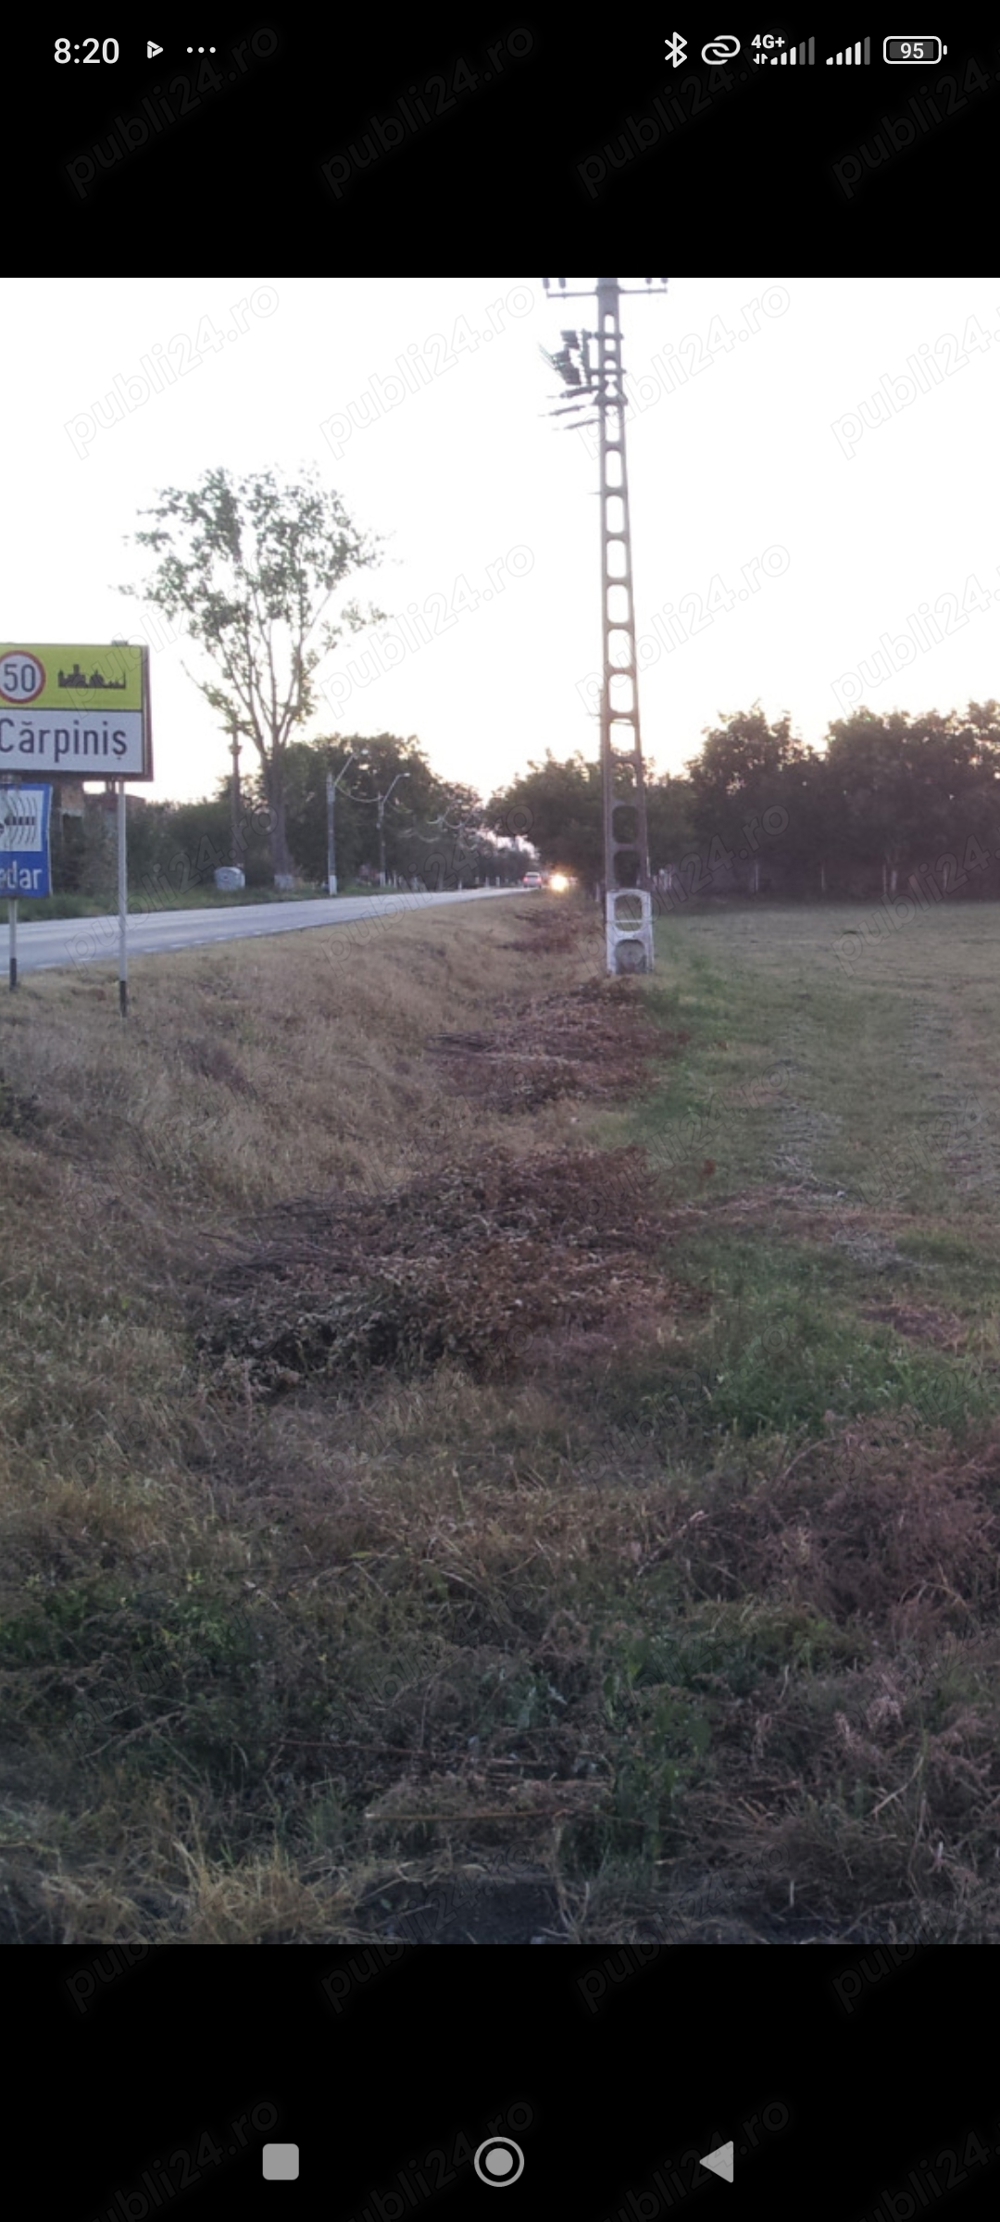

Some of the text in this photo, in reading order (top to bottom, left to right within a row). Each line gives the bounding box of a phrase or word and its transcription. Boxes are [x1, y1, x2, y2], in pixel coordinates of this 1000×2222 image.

[54, 38, 119, 63] 8:20
[751, 34, 785, 49] 4G+
[900, 42, 924, 60] 95
[4, 664, 36, 692] 50
[0, 718, 128, 763] Cărpiniș
